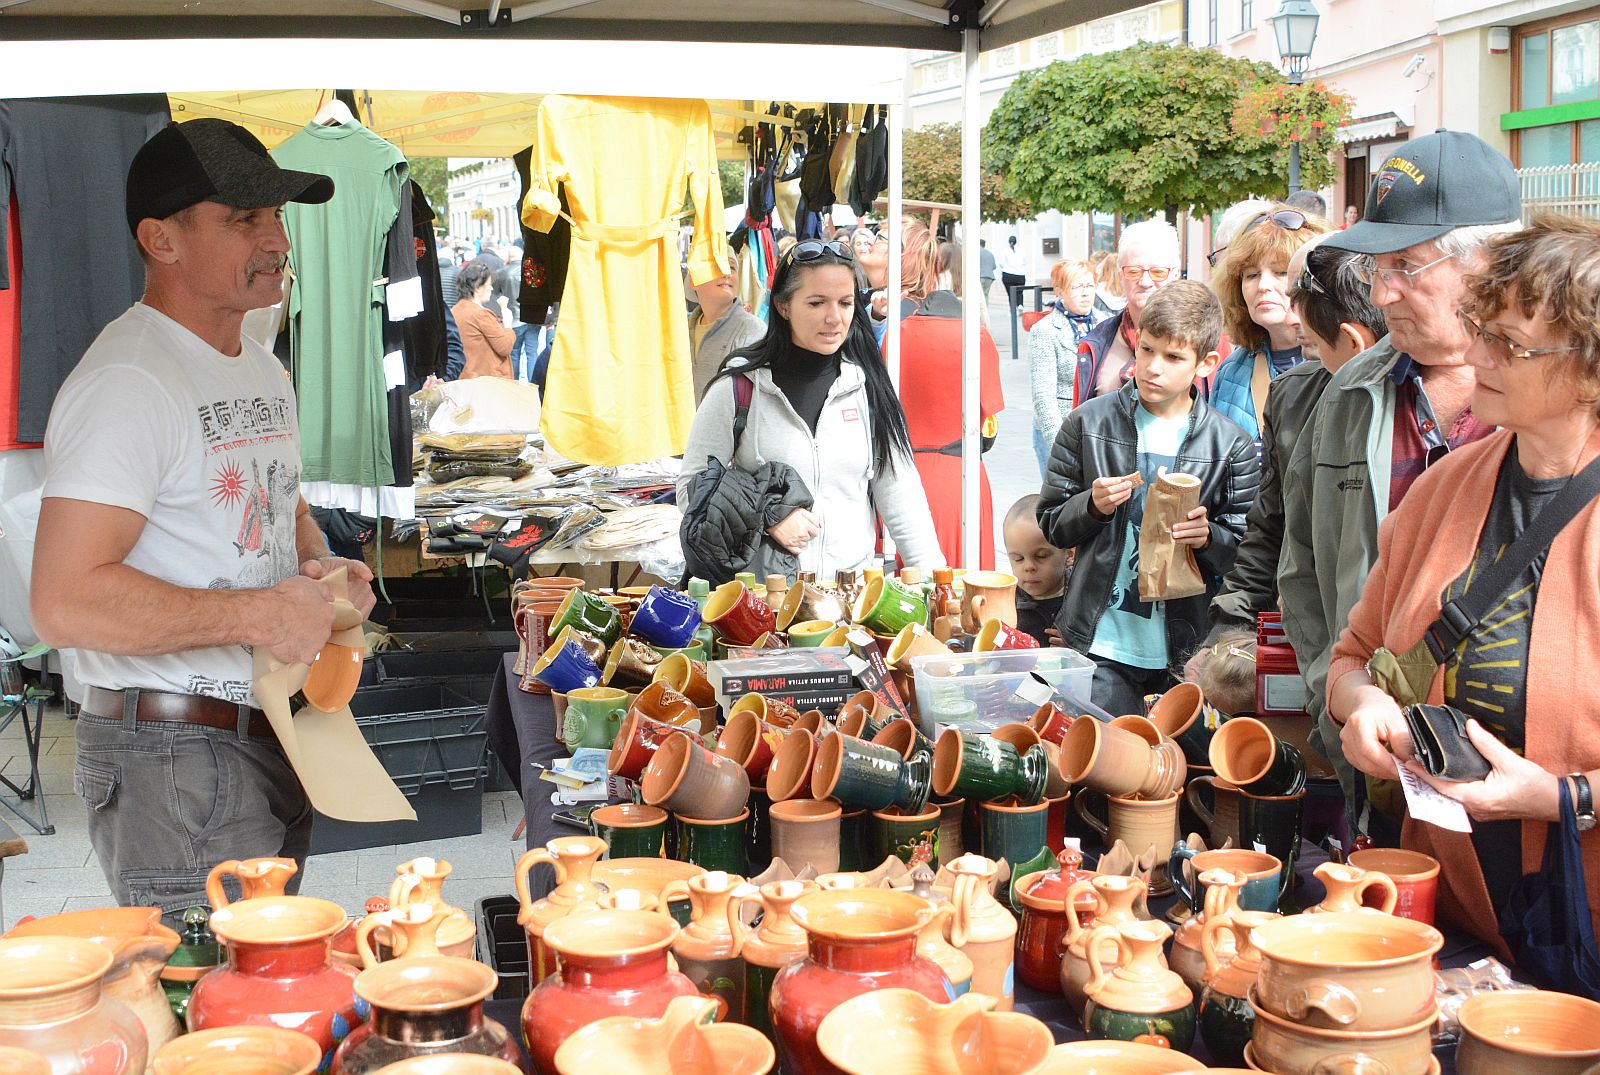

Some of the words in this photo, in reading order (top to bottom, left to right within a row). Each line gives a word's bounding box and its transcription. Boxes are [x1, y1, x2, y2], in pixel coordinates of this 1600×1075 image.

[747, 677, 787, 691] HARAMIA
[788, 678, 808, 686] ATTILA
[796, 697, 817, 705] ATTILA
[608, 776, 618, 798] 1000
